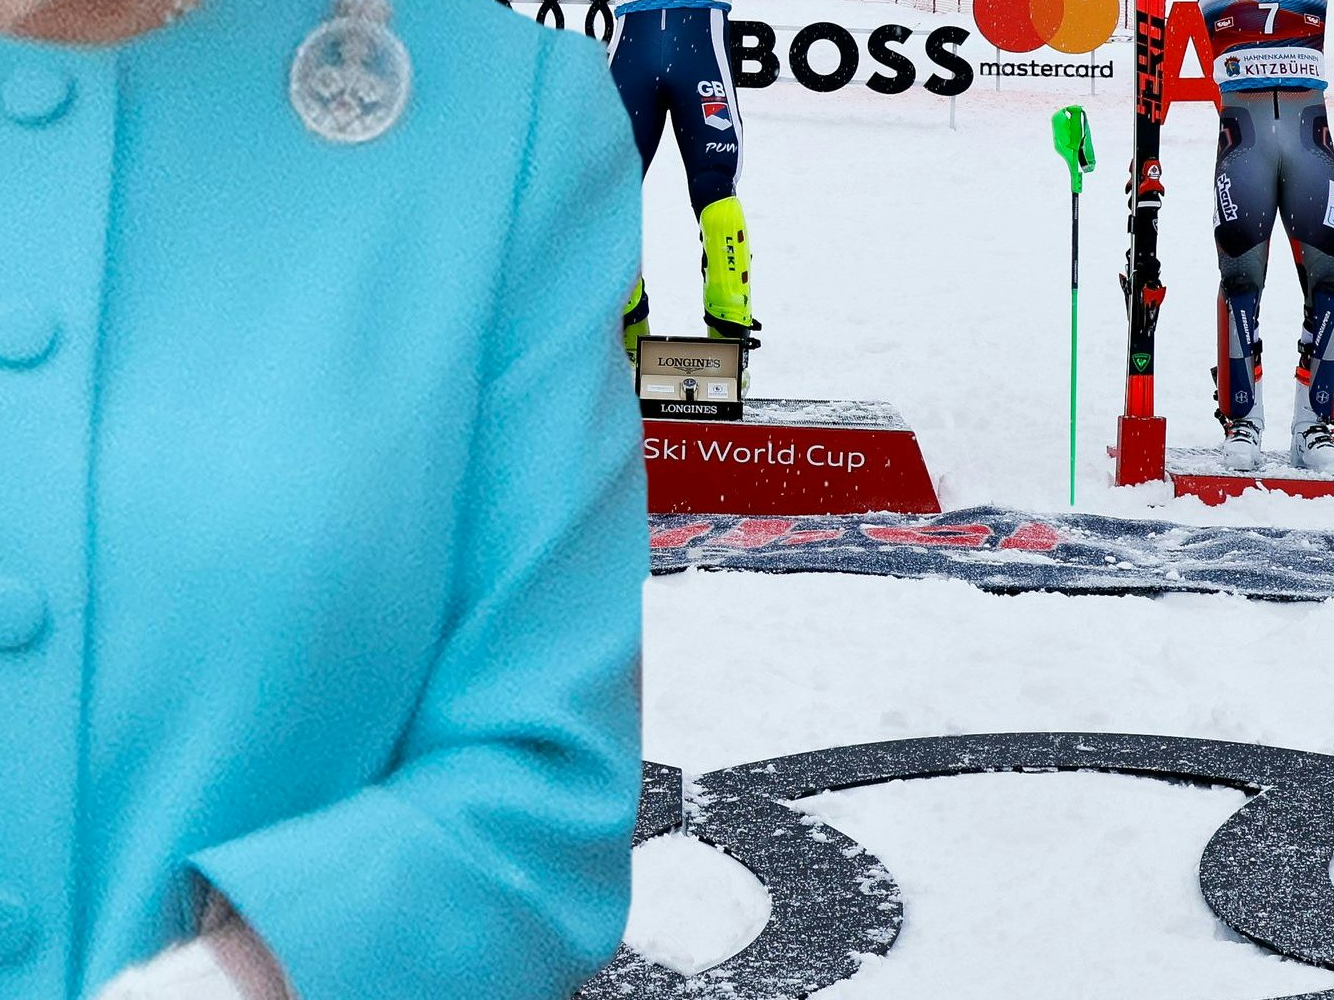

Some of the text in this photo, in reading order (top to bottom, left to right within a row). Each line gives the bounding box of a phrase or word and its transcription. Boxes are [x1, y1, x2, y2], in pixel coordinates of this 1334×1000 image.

[1258, 3, 1279, 34] 7
[731, 20, 974, 96] BOSS
[1163, 1, 1222, 125] A
[1243, 53, 1296, 62] HAHNENKAMM
[980, 59, 1114, 79] mastercard
[1245, 60, 1319, 77] KITZBÜHEL
[697, 80, 725, 98] GB
[1217, 174, 1238, 222] phenix
[658, 357, 721, 369] LONGINES
[660, 403, 717, 415] LONGINES
[644, 438, 865, 472] Ski World Cup
